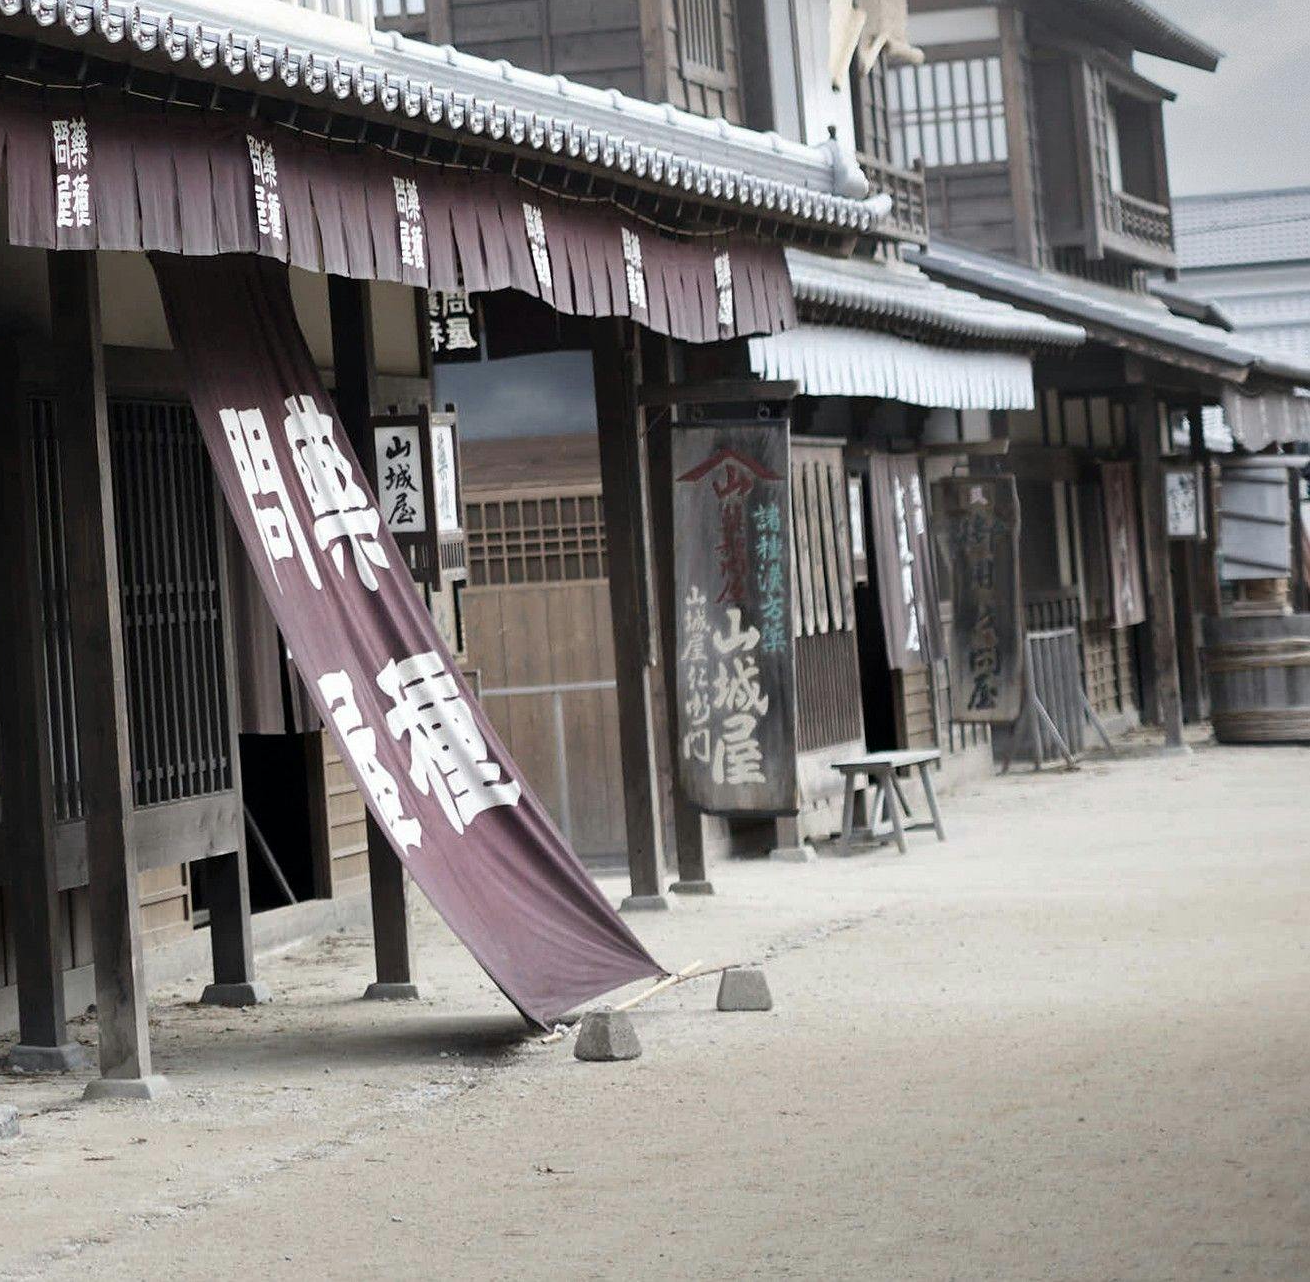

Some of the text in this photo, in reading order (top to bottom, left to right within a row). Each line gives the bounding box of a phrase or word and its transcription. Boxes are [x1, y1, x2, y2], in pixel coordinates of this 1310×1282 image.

[385, 435, 419, 526] 山城屋
[218, 407, 422, 857] 問屋
[712, 607, 769, 785] 山城屋
